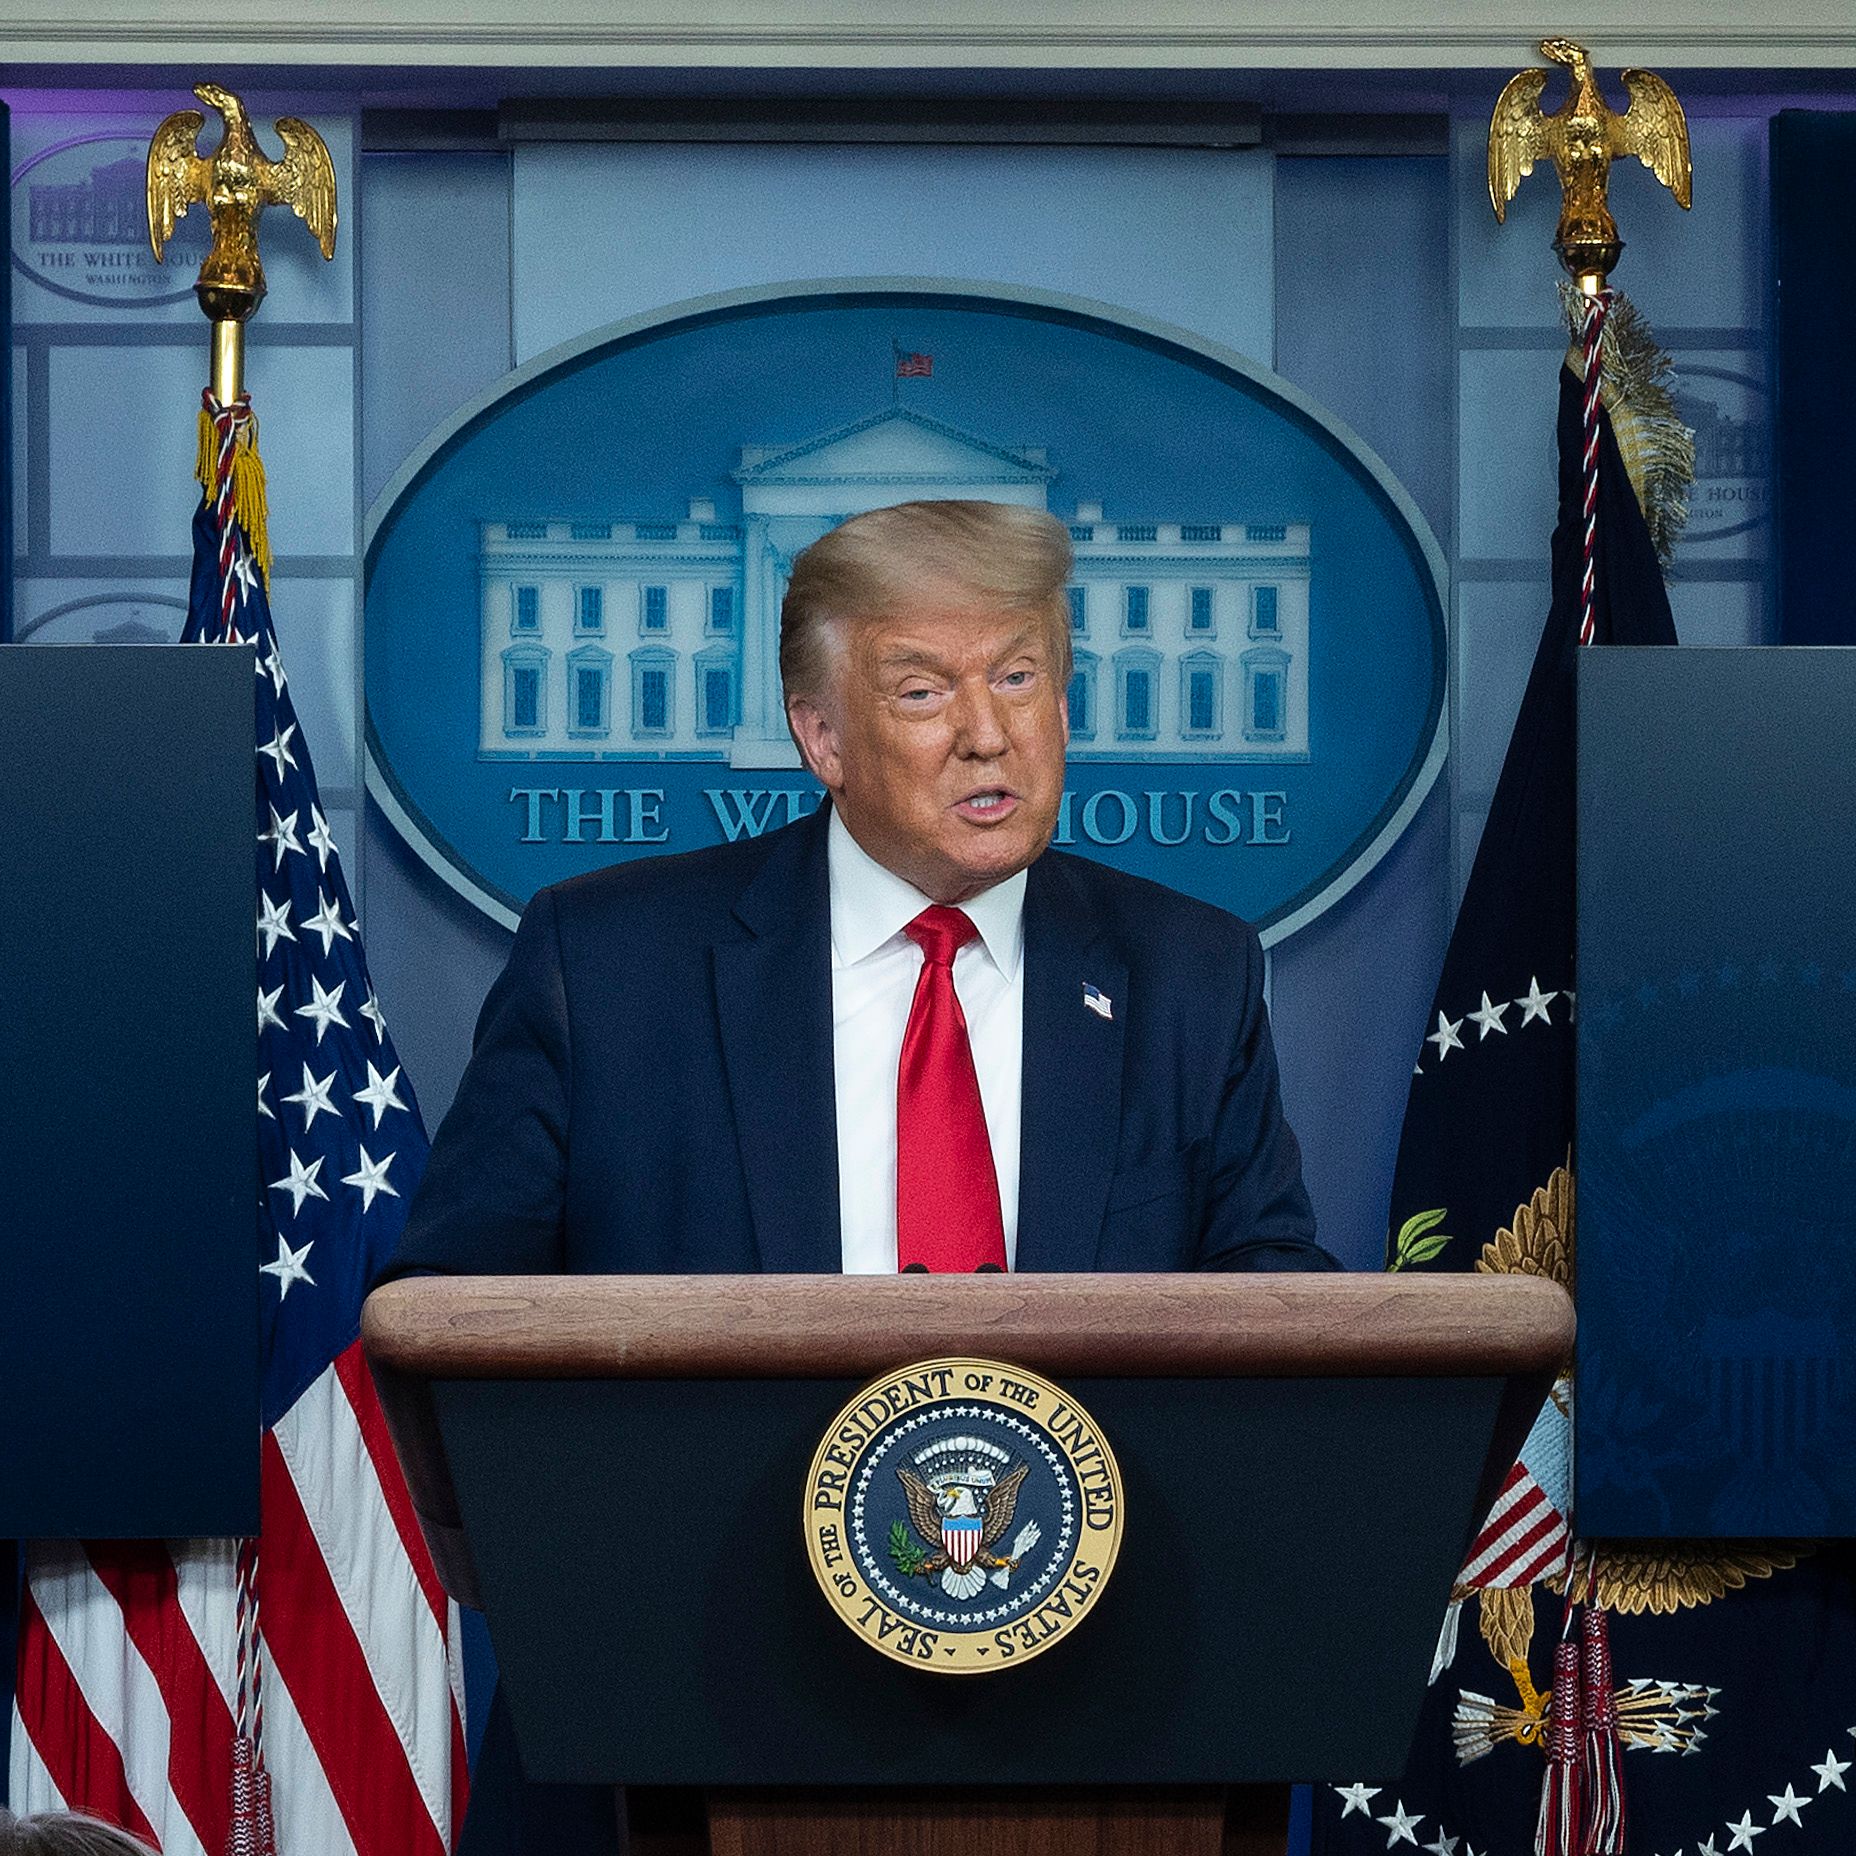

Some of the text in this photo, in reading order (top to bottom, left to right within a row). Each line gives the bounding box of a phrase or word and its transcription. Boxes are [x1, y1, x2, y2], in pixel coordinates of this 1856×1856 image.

[509, 787, 670, 844] THE
[815, 1369, 1114, 1660] SEAL OF THE PRESIDENT OF THE UNITED STATES
